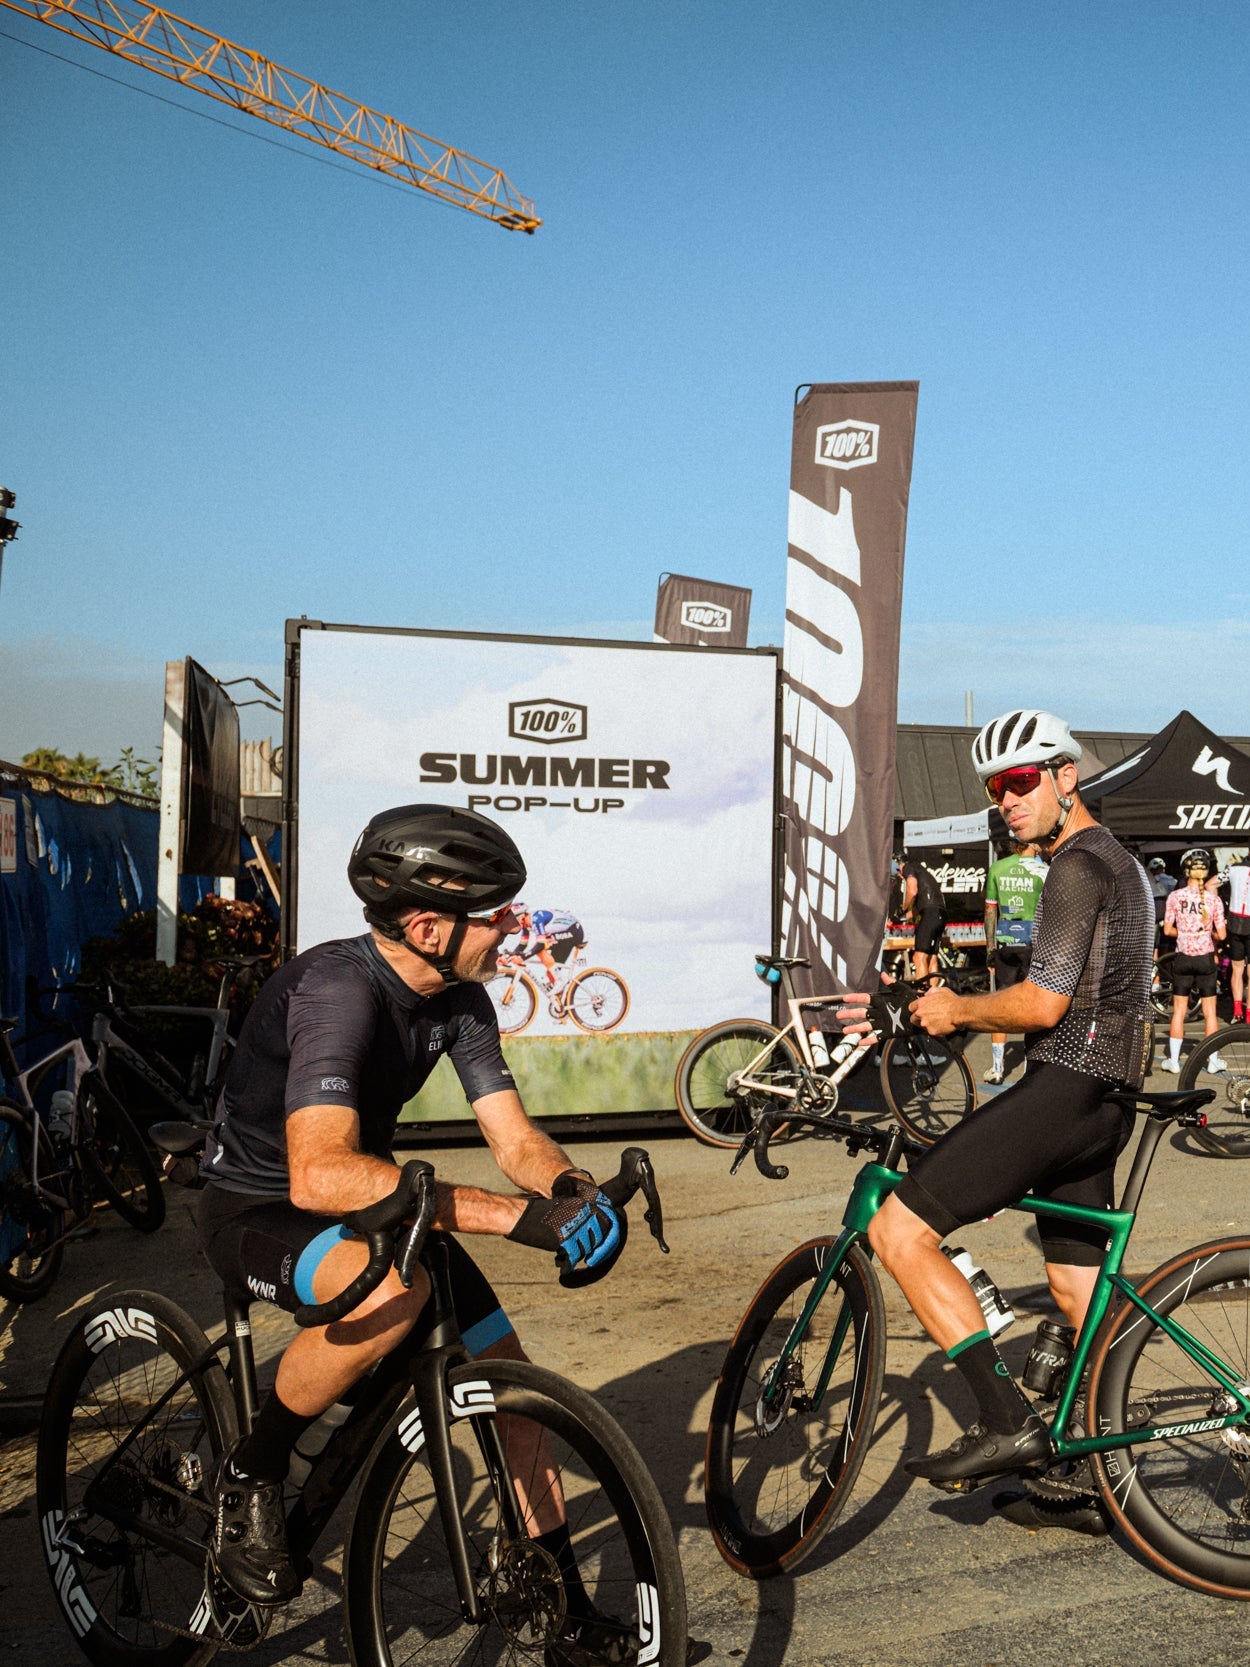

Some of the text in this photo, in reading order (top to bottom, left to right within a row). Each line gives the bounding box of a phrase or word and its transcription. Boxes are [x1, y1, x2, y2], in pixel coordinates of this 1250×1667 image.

[823, 431, 871, 458] 100%
[687, 607, 725, 627] 100%
[519, 710, 577, 733] 100%
[419, 752, 671, 790] SUMMER
[467, 795, 625, 814] POP-UP
[1000, 876, 1034, 887] TITAN
[1000, 885, 1034, 893] RACING
[247, 1275, 277, 1301] WNR
[1150, 1418, 1226, 1440] SPECIALIZED
